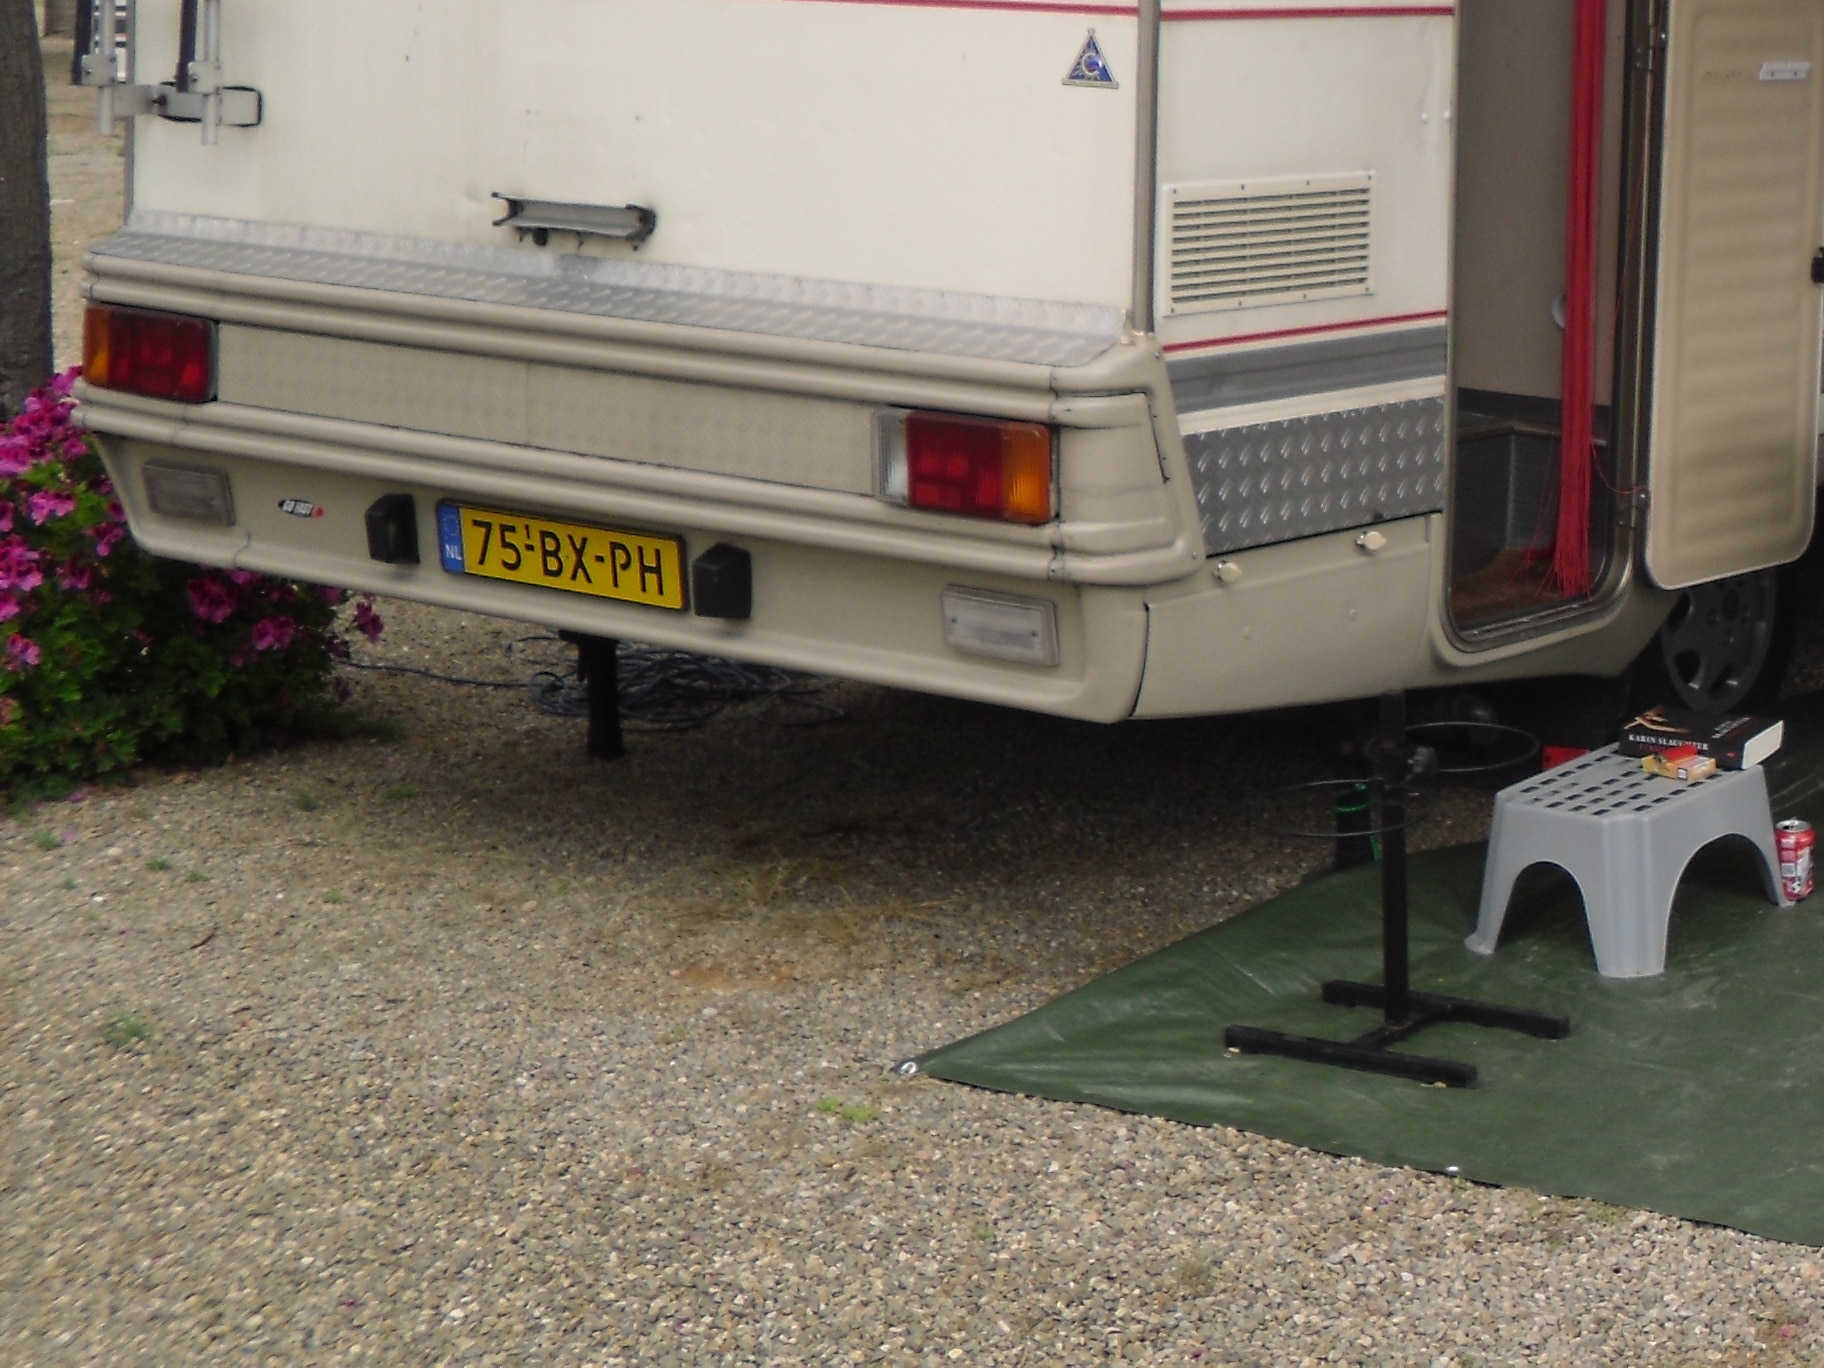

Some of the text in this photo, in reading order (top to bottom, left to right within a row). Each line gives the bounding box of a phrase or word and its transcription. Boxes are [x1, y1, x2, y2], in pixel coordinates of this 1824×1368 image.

[445, 543, 461, 560] NL
[472, 519, 664, 596] 75-BX-PH
[1628, 734, 1656, 744] KARIN
